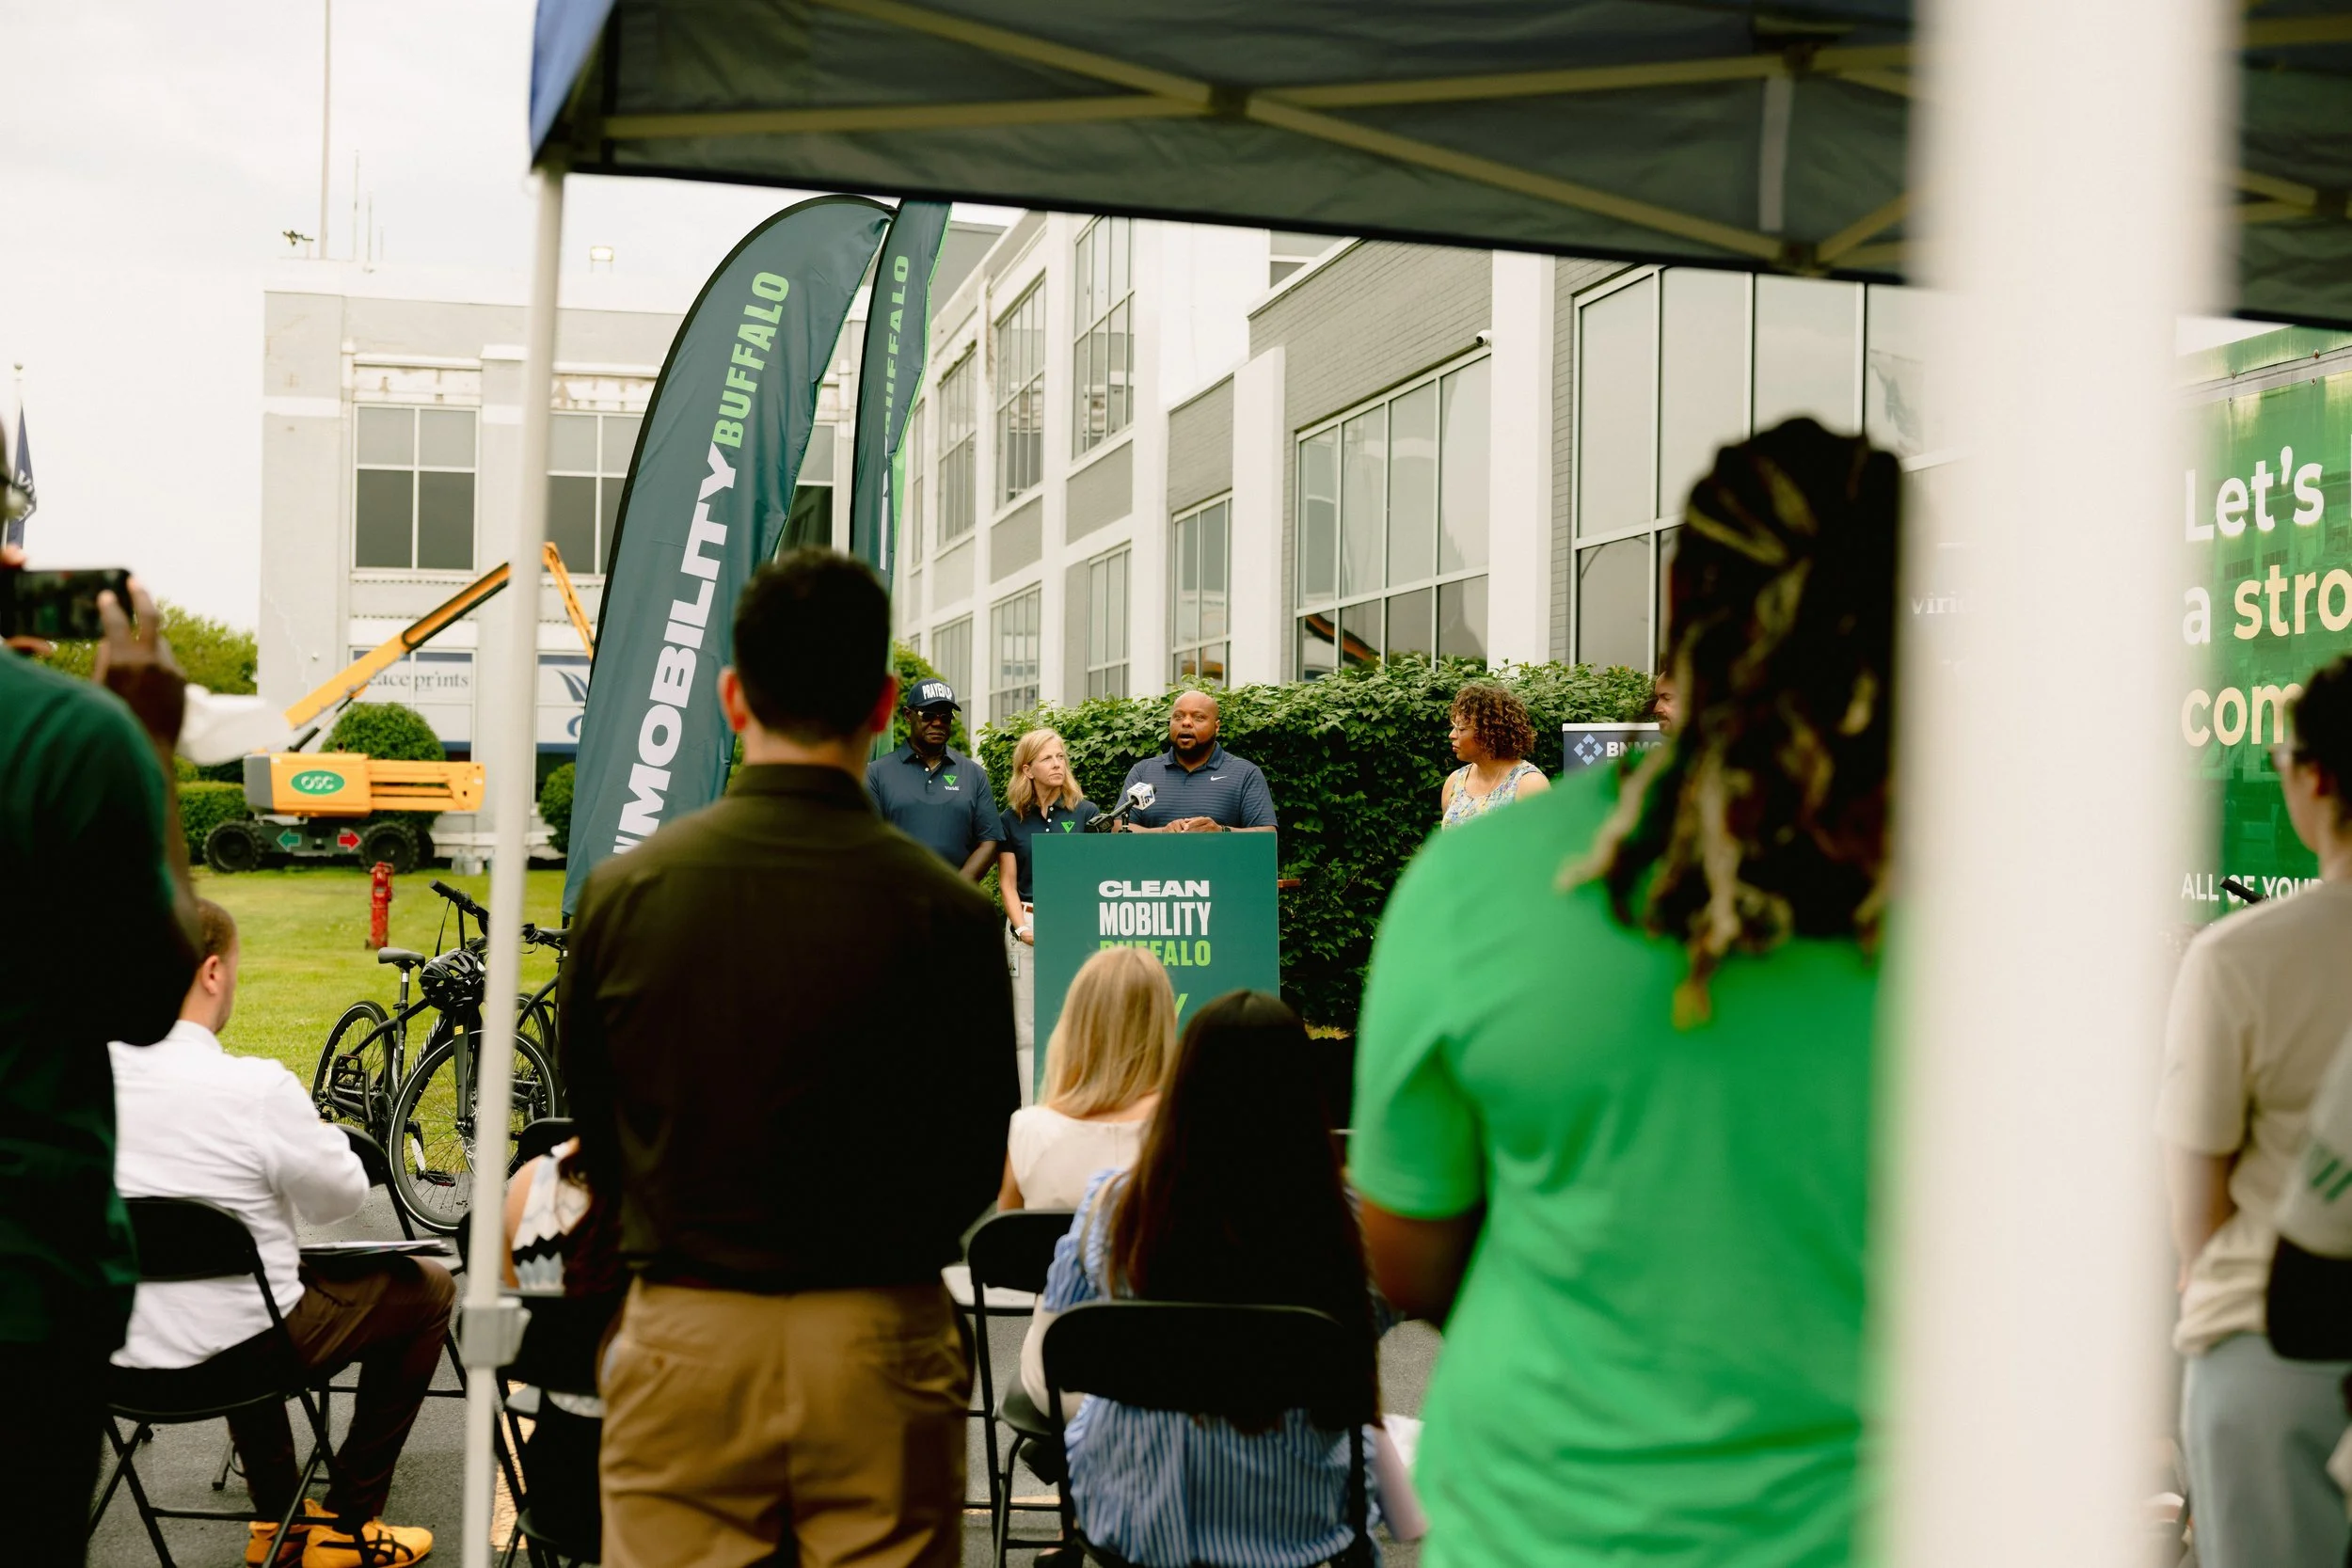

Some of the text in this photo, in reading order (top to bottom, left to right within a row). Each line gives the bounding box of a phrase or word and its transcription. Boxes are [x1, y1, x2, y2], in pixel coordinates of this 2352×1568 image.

[2185, 445, 2325, 543] Let's
[618, 271, 789, 837] MOBILITY BUFFALO
[2183, 585, 2211, 646] a
[368, 671, 469, 692] eace prints
[1098, 879, 1210, 898] CLEAN
[2181, 872, 2220, 902] ALL
[1099, 901, 1212, 937] MOBILITY
[1100, 940, 1212, 967] FALO
